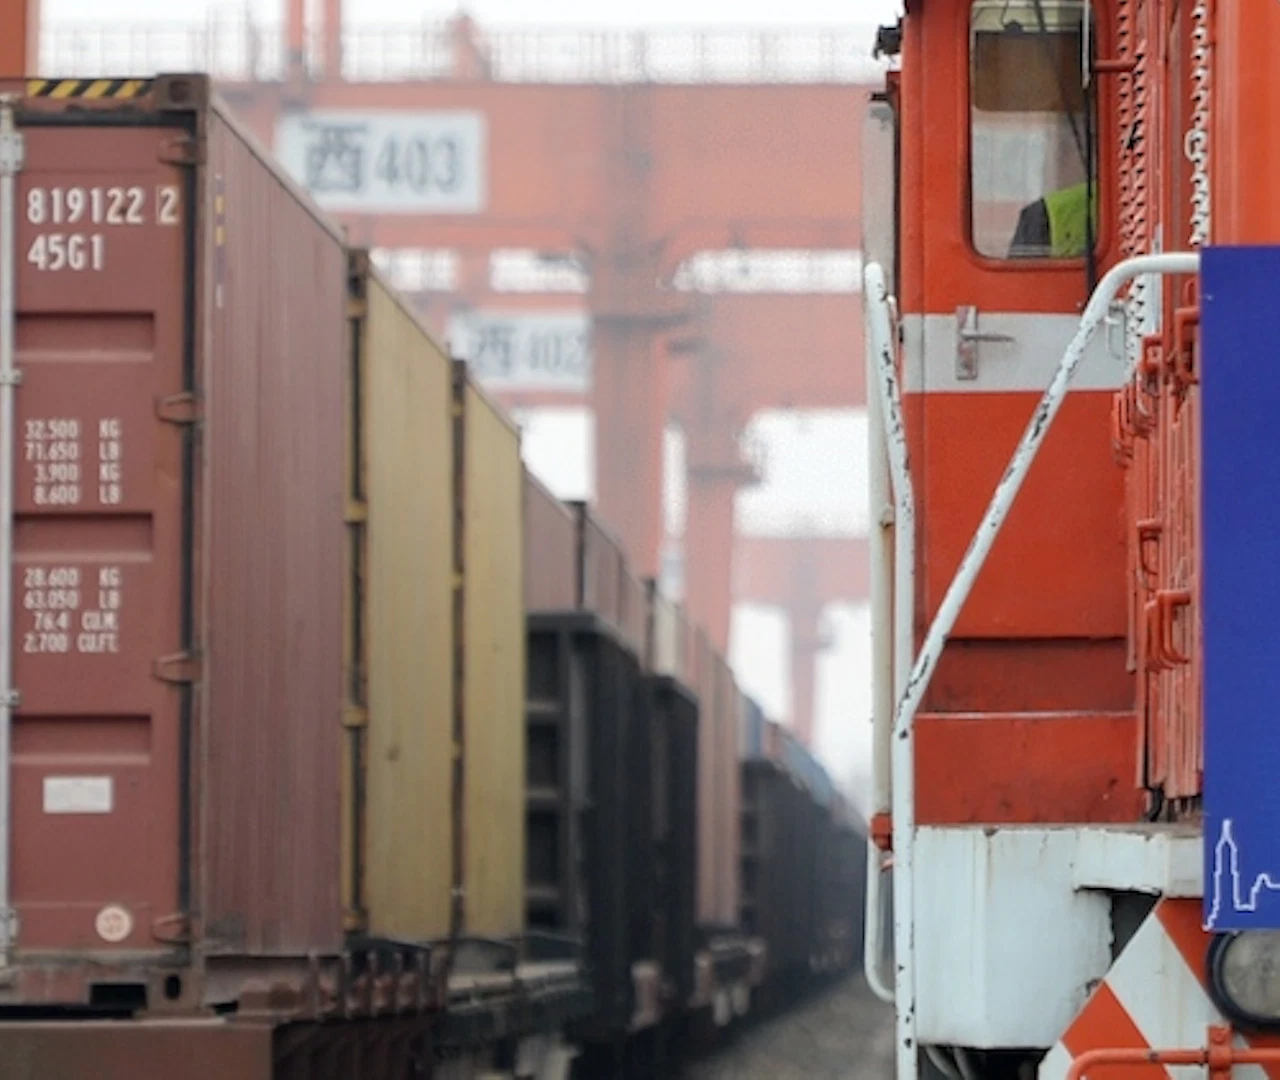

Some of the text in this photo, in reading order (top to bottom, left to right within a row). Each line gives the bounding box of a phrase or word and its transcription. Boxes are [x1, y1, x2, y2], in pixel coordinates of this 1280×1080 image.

[26, 186, 145, 225] 819122
[26, 233, 104, 271] 45G1
[99, 419, 120, 439] KG
[99, 440, 120, 461] LB
[99, 462, 120, 482] KG
[99, 483, 120, 504] LB
[99, 567, 120, 587] KG
[99, 588, 120, 610] LB
